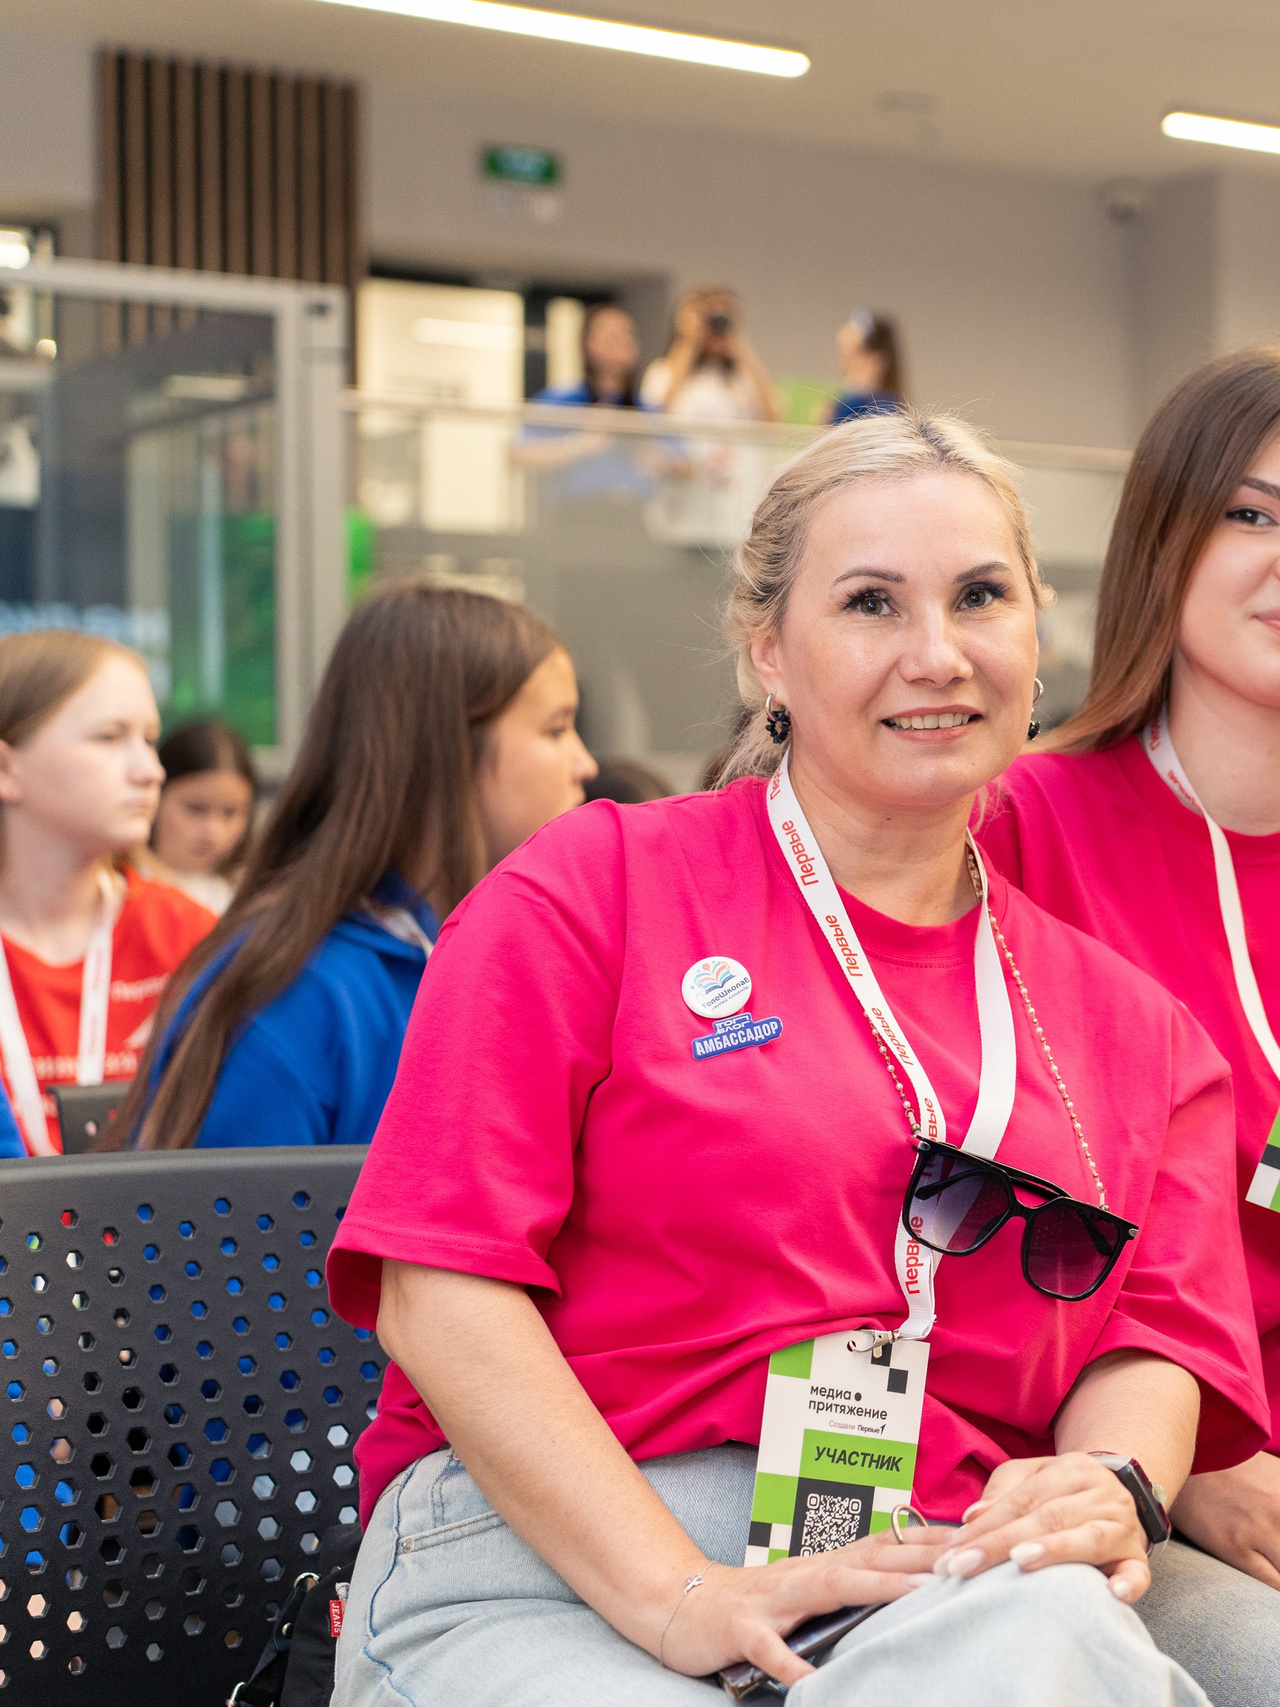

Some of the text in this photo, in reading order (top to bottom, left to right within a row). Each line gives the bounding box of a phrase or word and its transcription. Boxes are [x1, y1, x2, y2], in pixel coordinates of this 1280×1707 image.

[782, 819, 819, 886] Первые
[825, 914, 863, 977] Первые
[695, 1020, 779, 1056] АМБАССАДОР
[871, 1007, 914, 1066] Первые
[809, 1385, 852, 1401] медиа
[808, 1399, 888, 1420] притяжение
[828, 1419, 880, 1434] Создали Первые
[814, 1445, 904, 1473] УЧАСТНИК
[332, 1603, 341, 1633] JEANS
